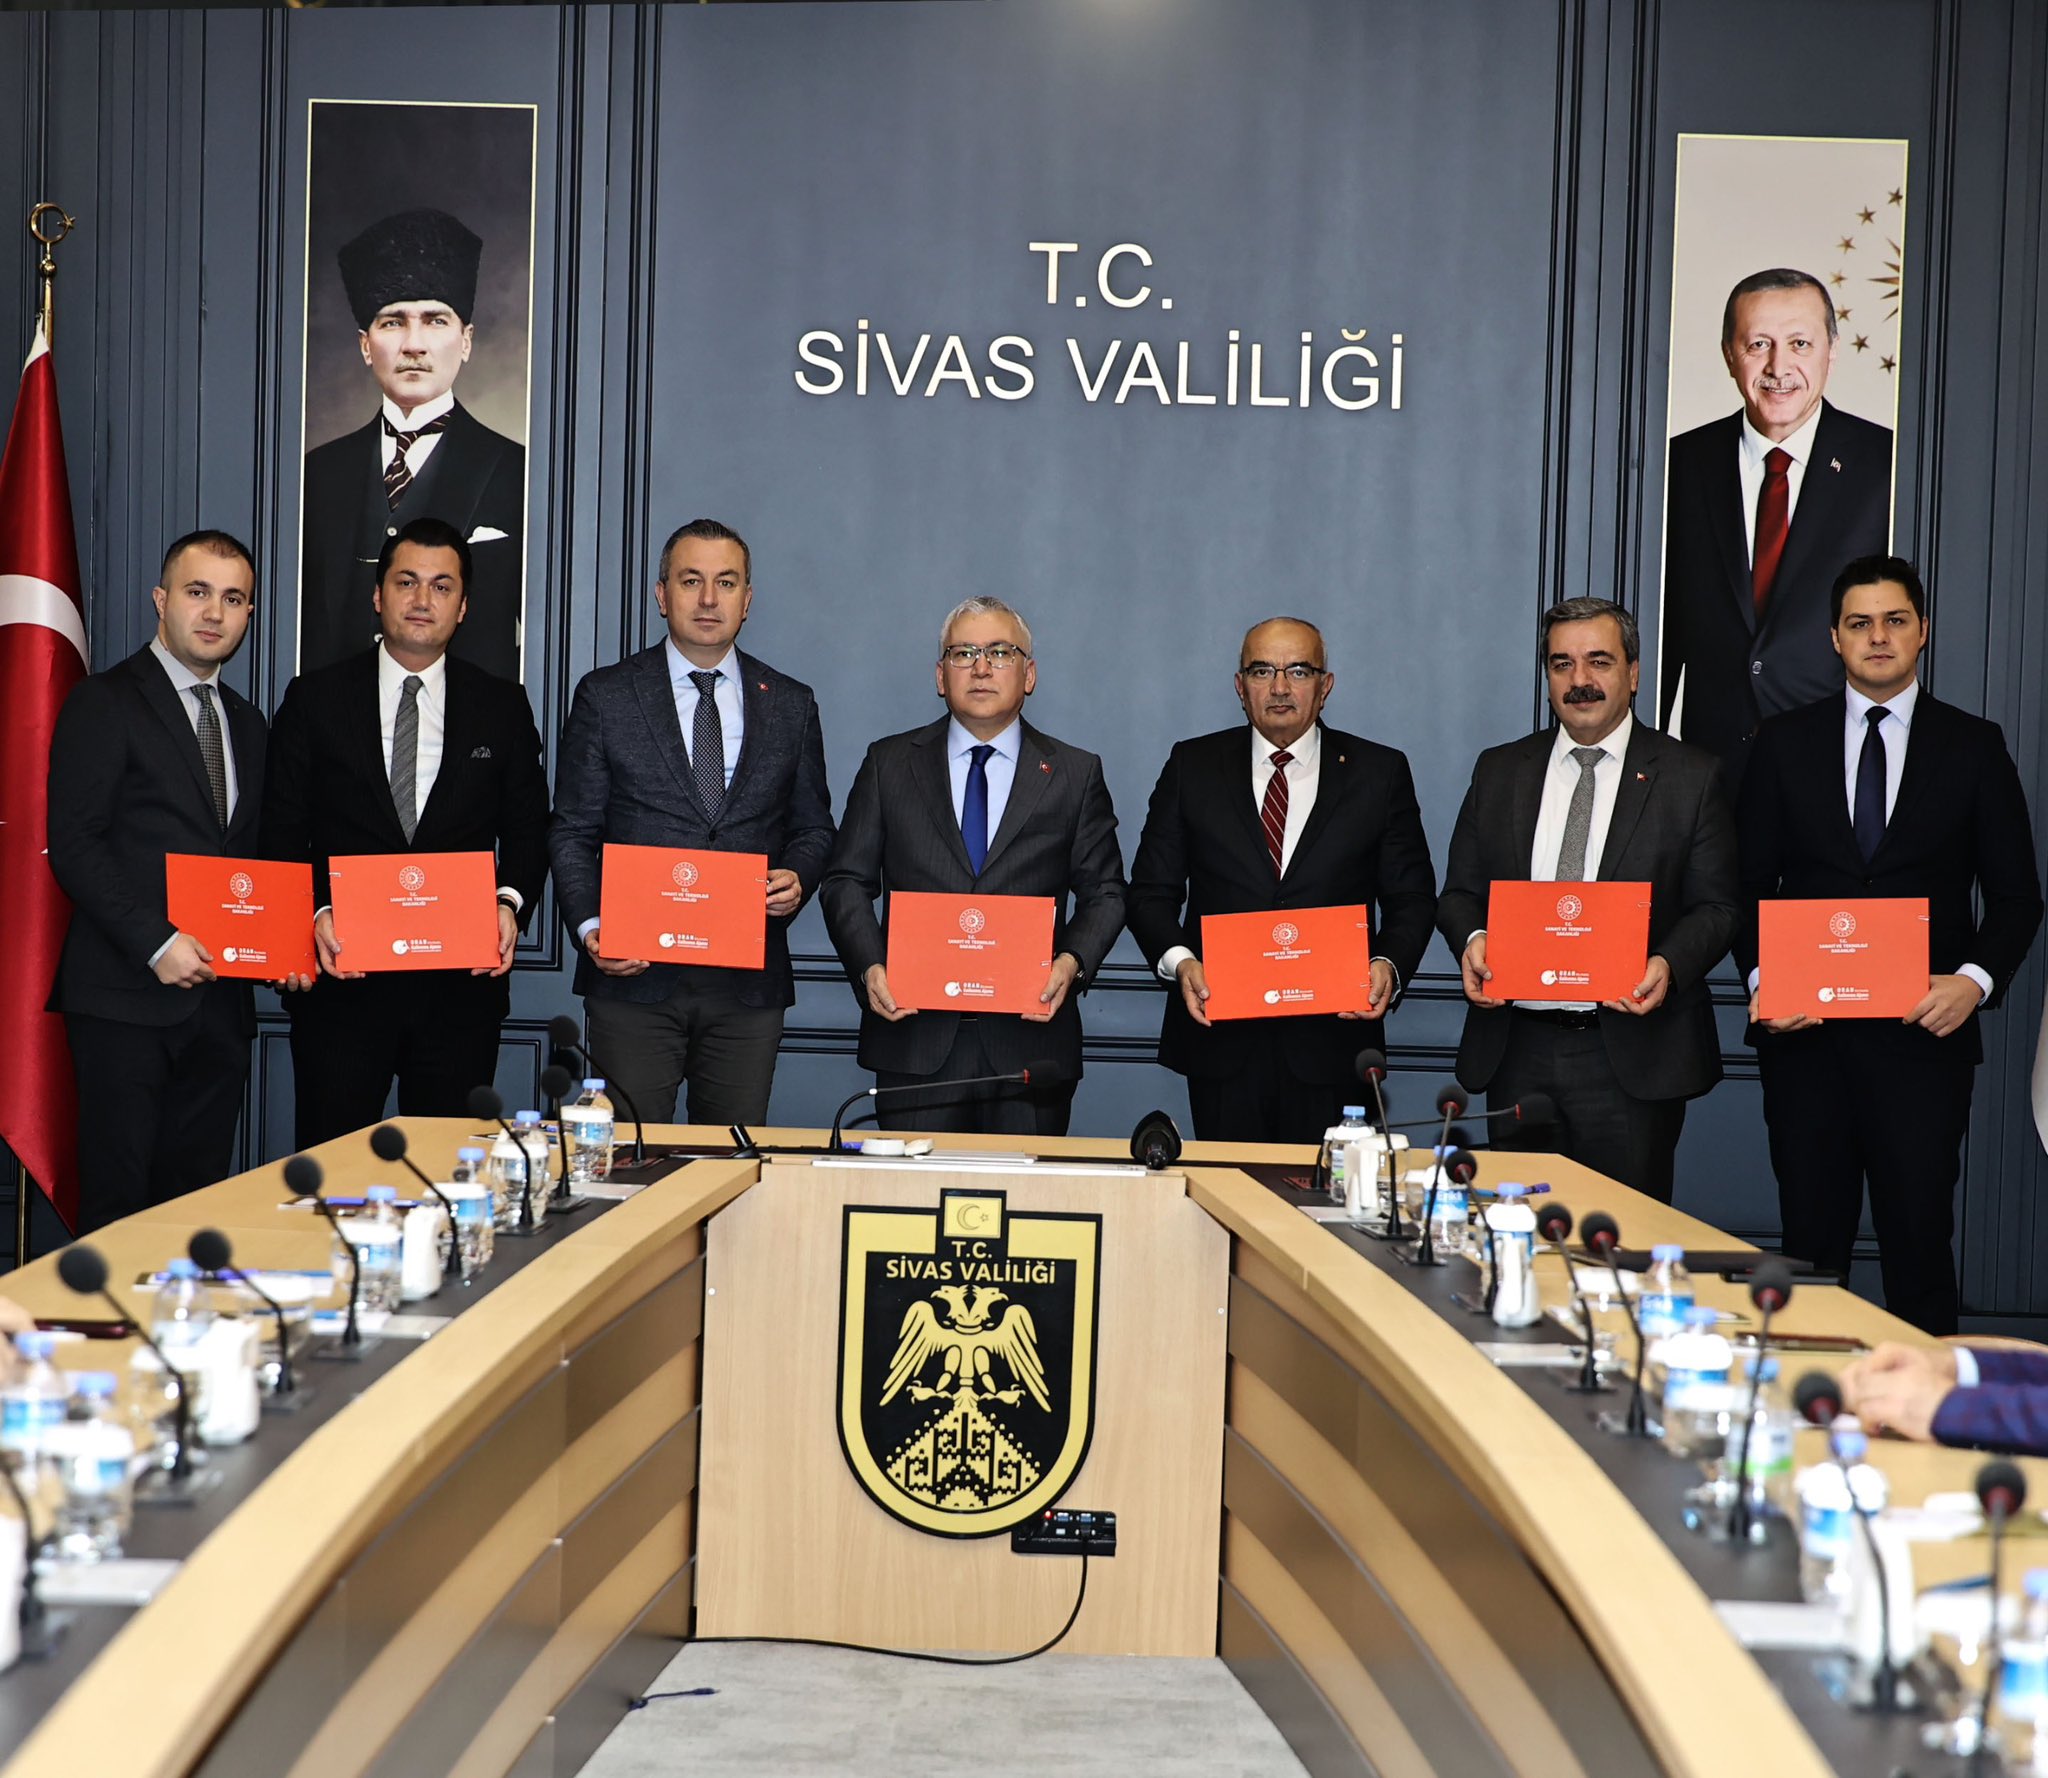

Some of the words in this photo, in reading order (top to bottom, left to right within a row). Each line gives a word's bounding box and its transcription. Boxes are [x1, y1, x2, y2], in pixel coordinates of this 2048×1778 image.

[1029, 241, 1173, 310] T.C.
[794, 318, 1036, 401] SİVAS
[1066, 327, 1404, 411] VALİLİĞİ
[886, 1255, 953, 1281] SİVAS
[959, 1260, 1056, 1285] VALİLİĞİ
[951, 1240, 993, 1259] T.C.
